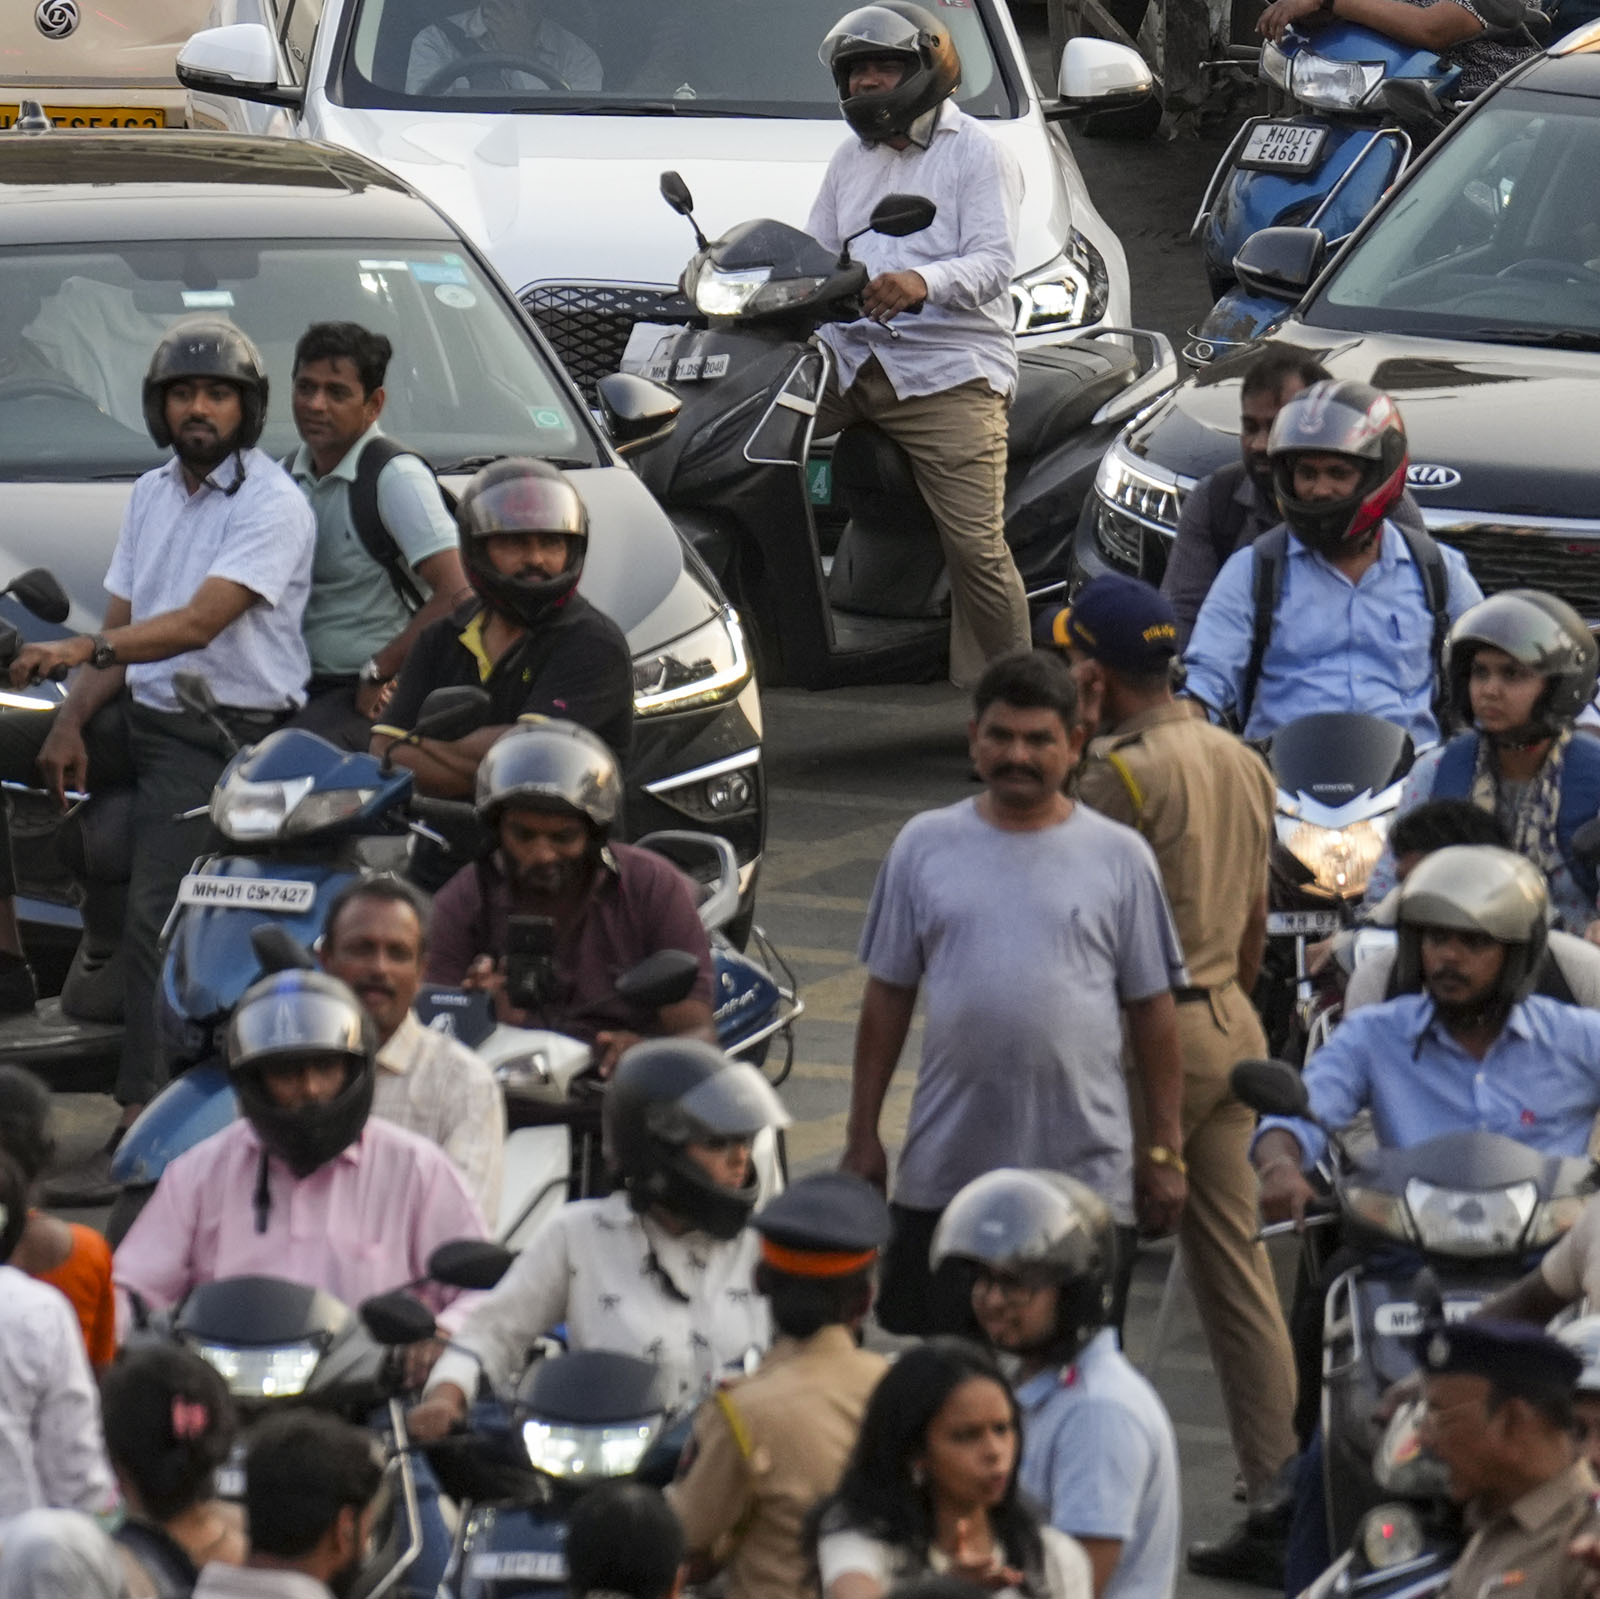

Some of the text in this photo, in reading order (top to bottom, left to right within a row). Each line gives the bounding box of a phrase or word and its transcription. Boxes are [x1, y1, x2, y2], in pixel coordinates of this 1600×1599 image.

[1266, 126, 1317, 146] MH01C
[1258, 143, 1308, 163] E4661
[1408, 466, 1446, 483] KIA
